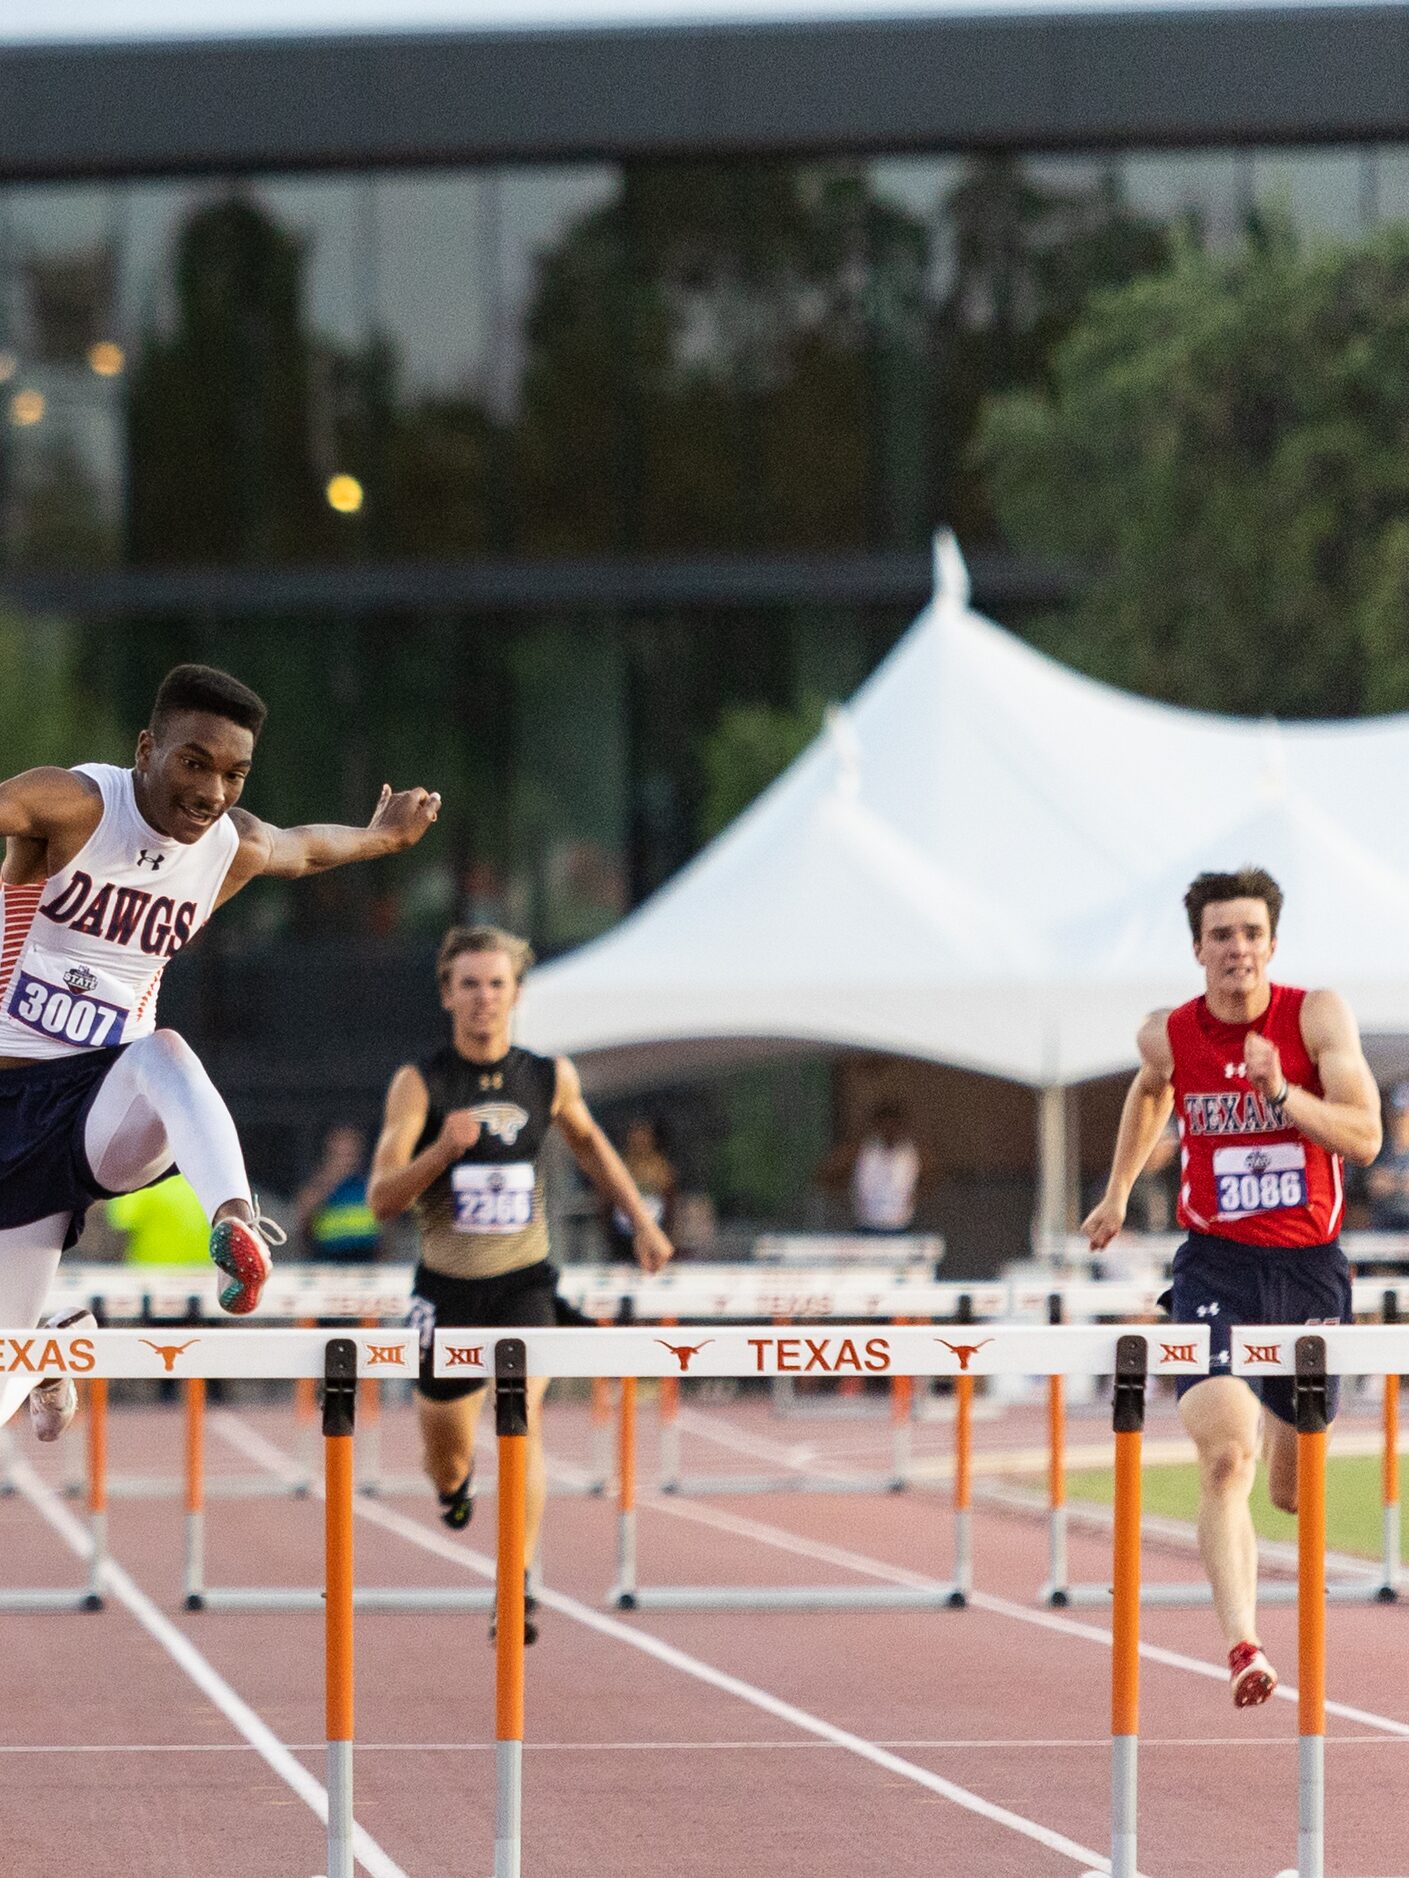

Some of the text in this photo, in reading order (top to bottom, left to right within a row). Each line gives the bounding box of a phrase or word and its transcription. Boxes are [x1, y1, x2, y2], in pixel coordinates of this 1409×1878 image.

[39, 870, 198, 957] DAWGS
[63, 970, 98, 991] STATE
[18, 981, 117, 1047] 3007
[1219, 1171, 1302, 1211] 3086
[747, 1337, 892, 1372] TEXAS
